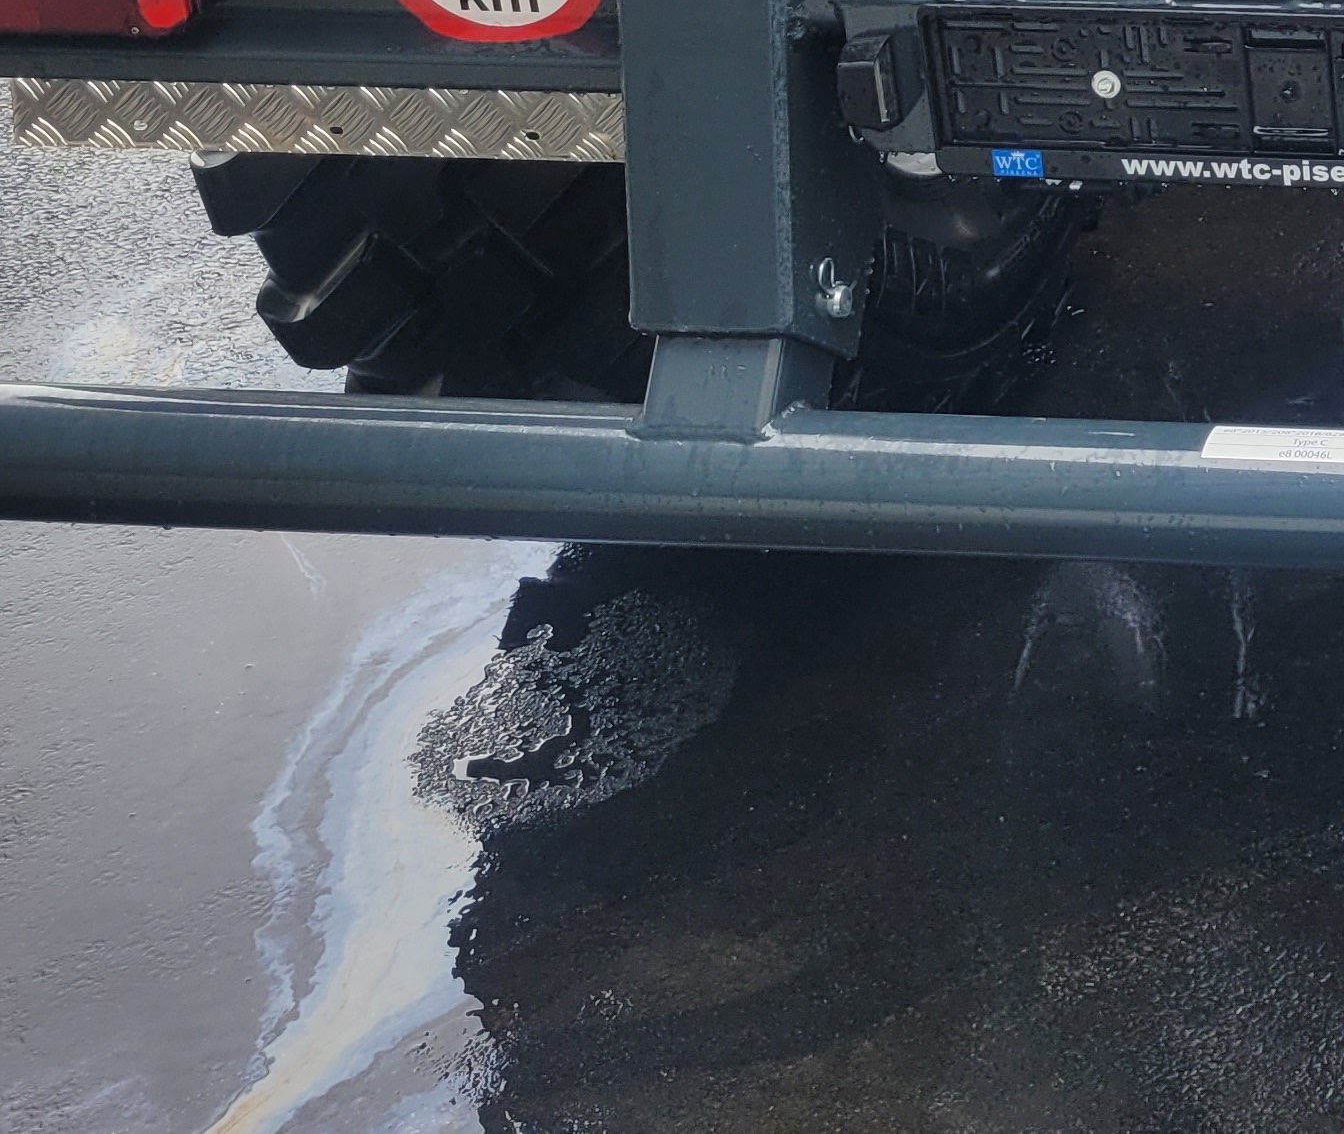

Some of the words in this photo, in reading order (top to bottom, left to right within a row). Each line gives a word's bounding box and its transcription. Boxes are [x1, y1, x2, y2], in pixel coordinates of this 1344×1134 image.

[994, 154, 1039, 171] WTC
[1292, 437, 1318, 447] Type
[1319, 438, 1329, 447] C
[1278, 450, 1292, 459] e8
[1294, 450, 1333, 460] 00046L
